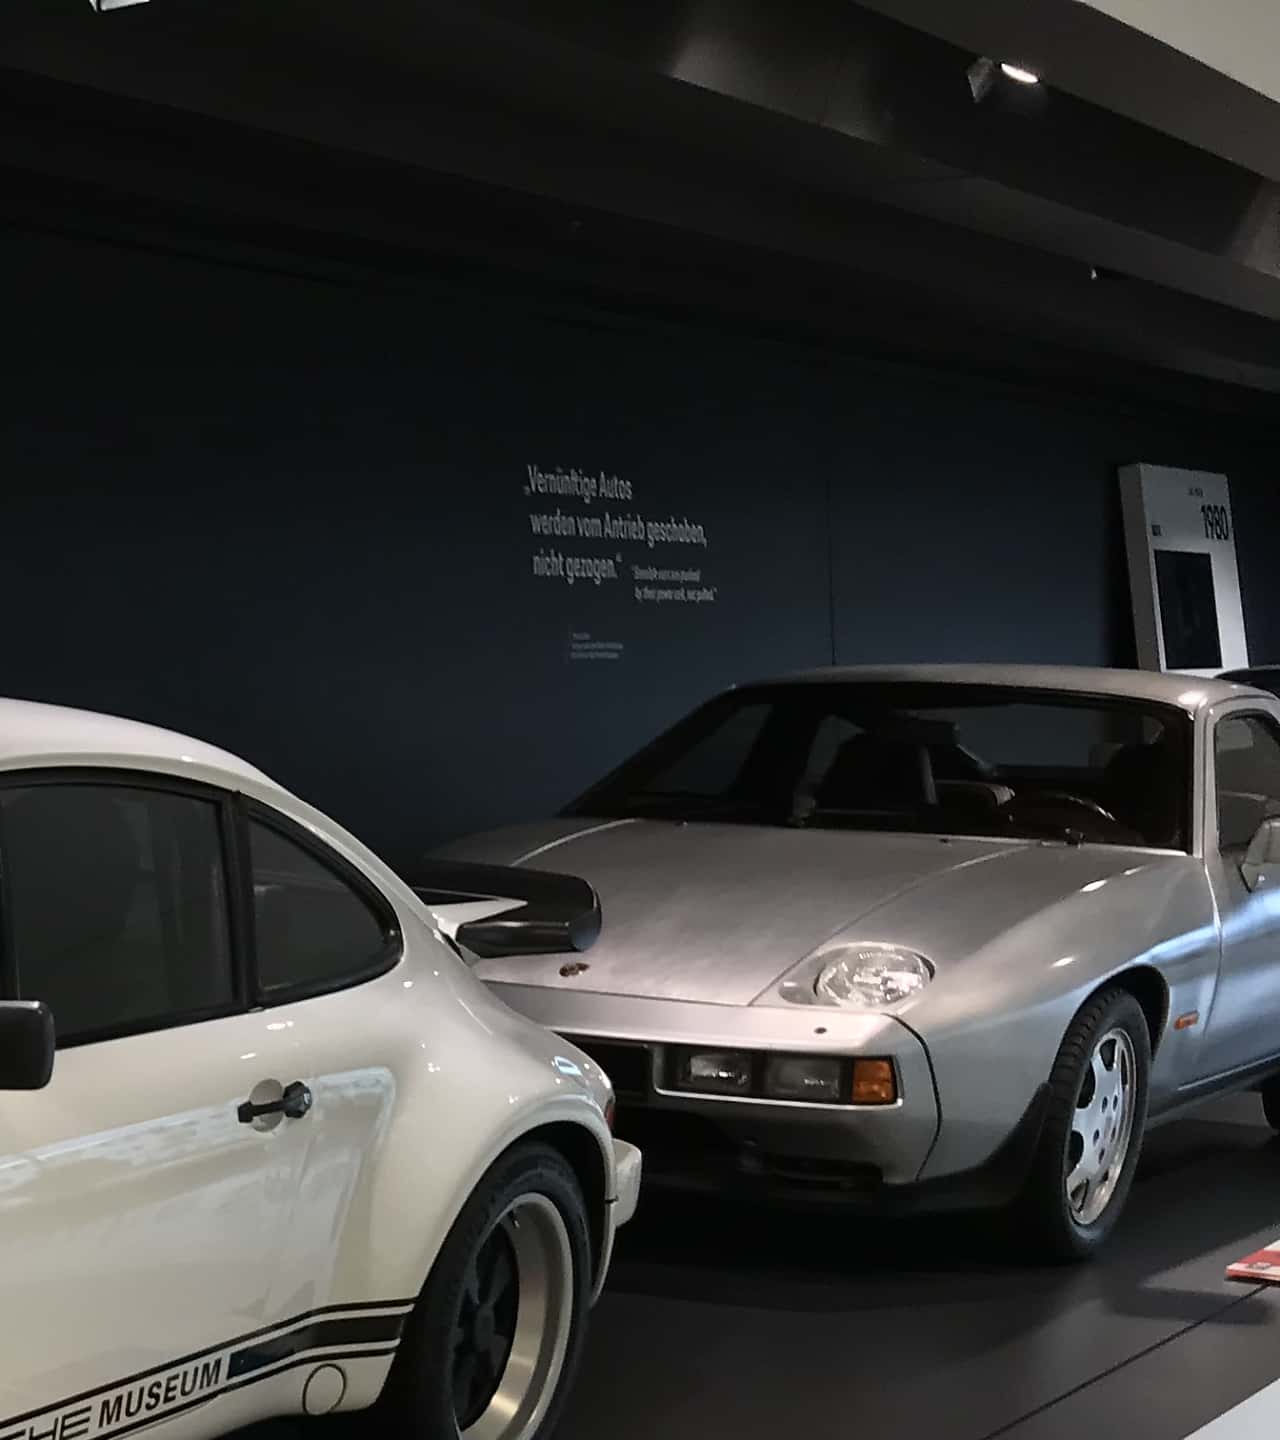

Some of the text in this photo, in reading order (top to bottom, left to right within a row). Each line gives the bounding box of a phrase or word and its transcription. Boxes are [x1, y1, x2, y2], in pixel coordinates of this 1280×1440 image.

[599, 470, 632, 500] Autos
[529, 507, 576, 537] werden
[576, 515, 602, 538] vom
[603, 511, 645, 541] Antrieb
[1200, 504, 1229, 540] 1980
[532, 548, 565, 577] nicht
[98, 1357, 223, 1428] MUSEUM
